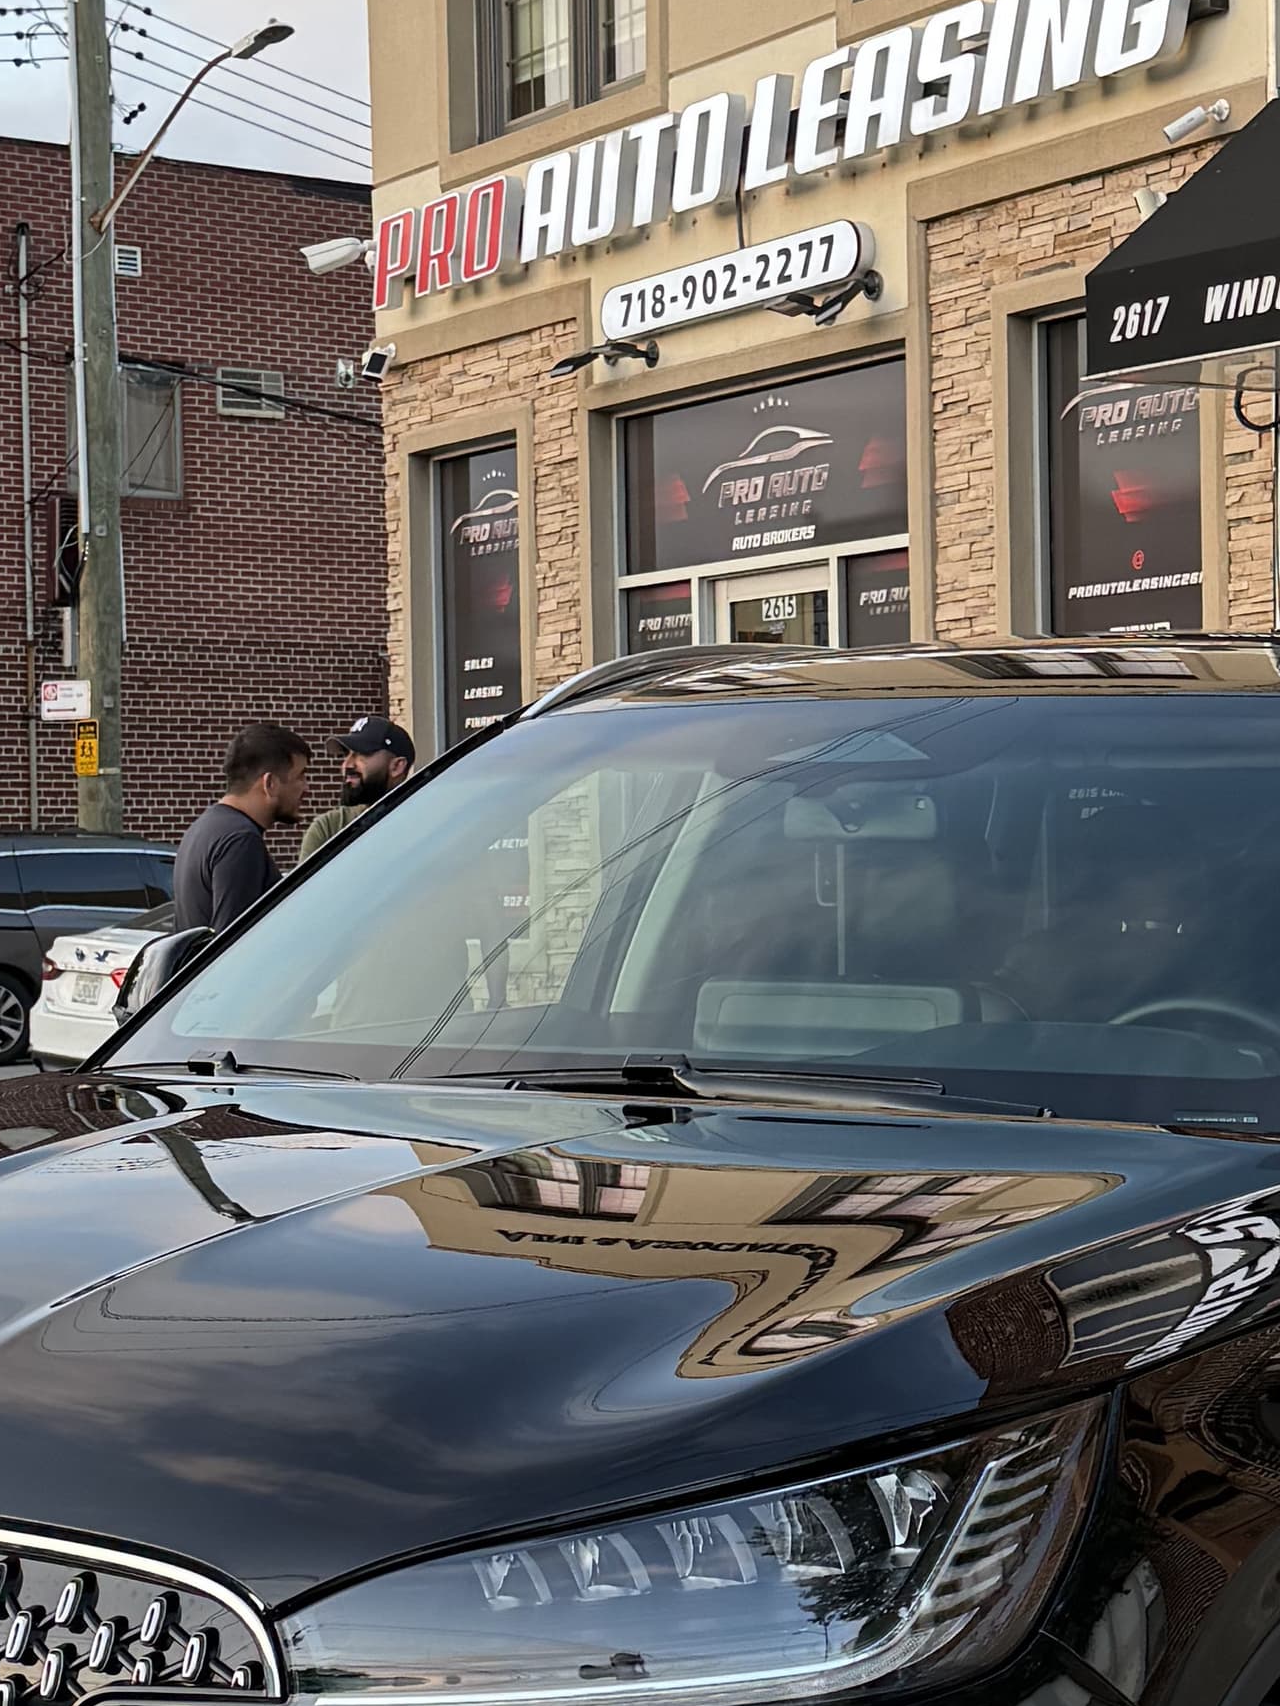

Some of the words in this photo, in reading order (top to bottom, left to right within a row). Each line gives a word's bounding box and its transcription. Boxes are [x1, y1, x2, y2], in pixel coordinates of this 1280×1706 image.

[373, 173, 519, 311] PRO
[519, 91, 743, 265] AUTO
[620, 233, 837, 329] 718-902-2277
[1110, 296, 1170, 343] 2617
[1079, 400, 1131, 431] PRO
[718, 476, 765, 509] PRO
[767, 463, 830, 499] AUTO
[732, 534, 762, 551] AUTO
[762, 525, 816, 547] BROKERS
[764, 596, 795, 618] 2615
